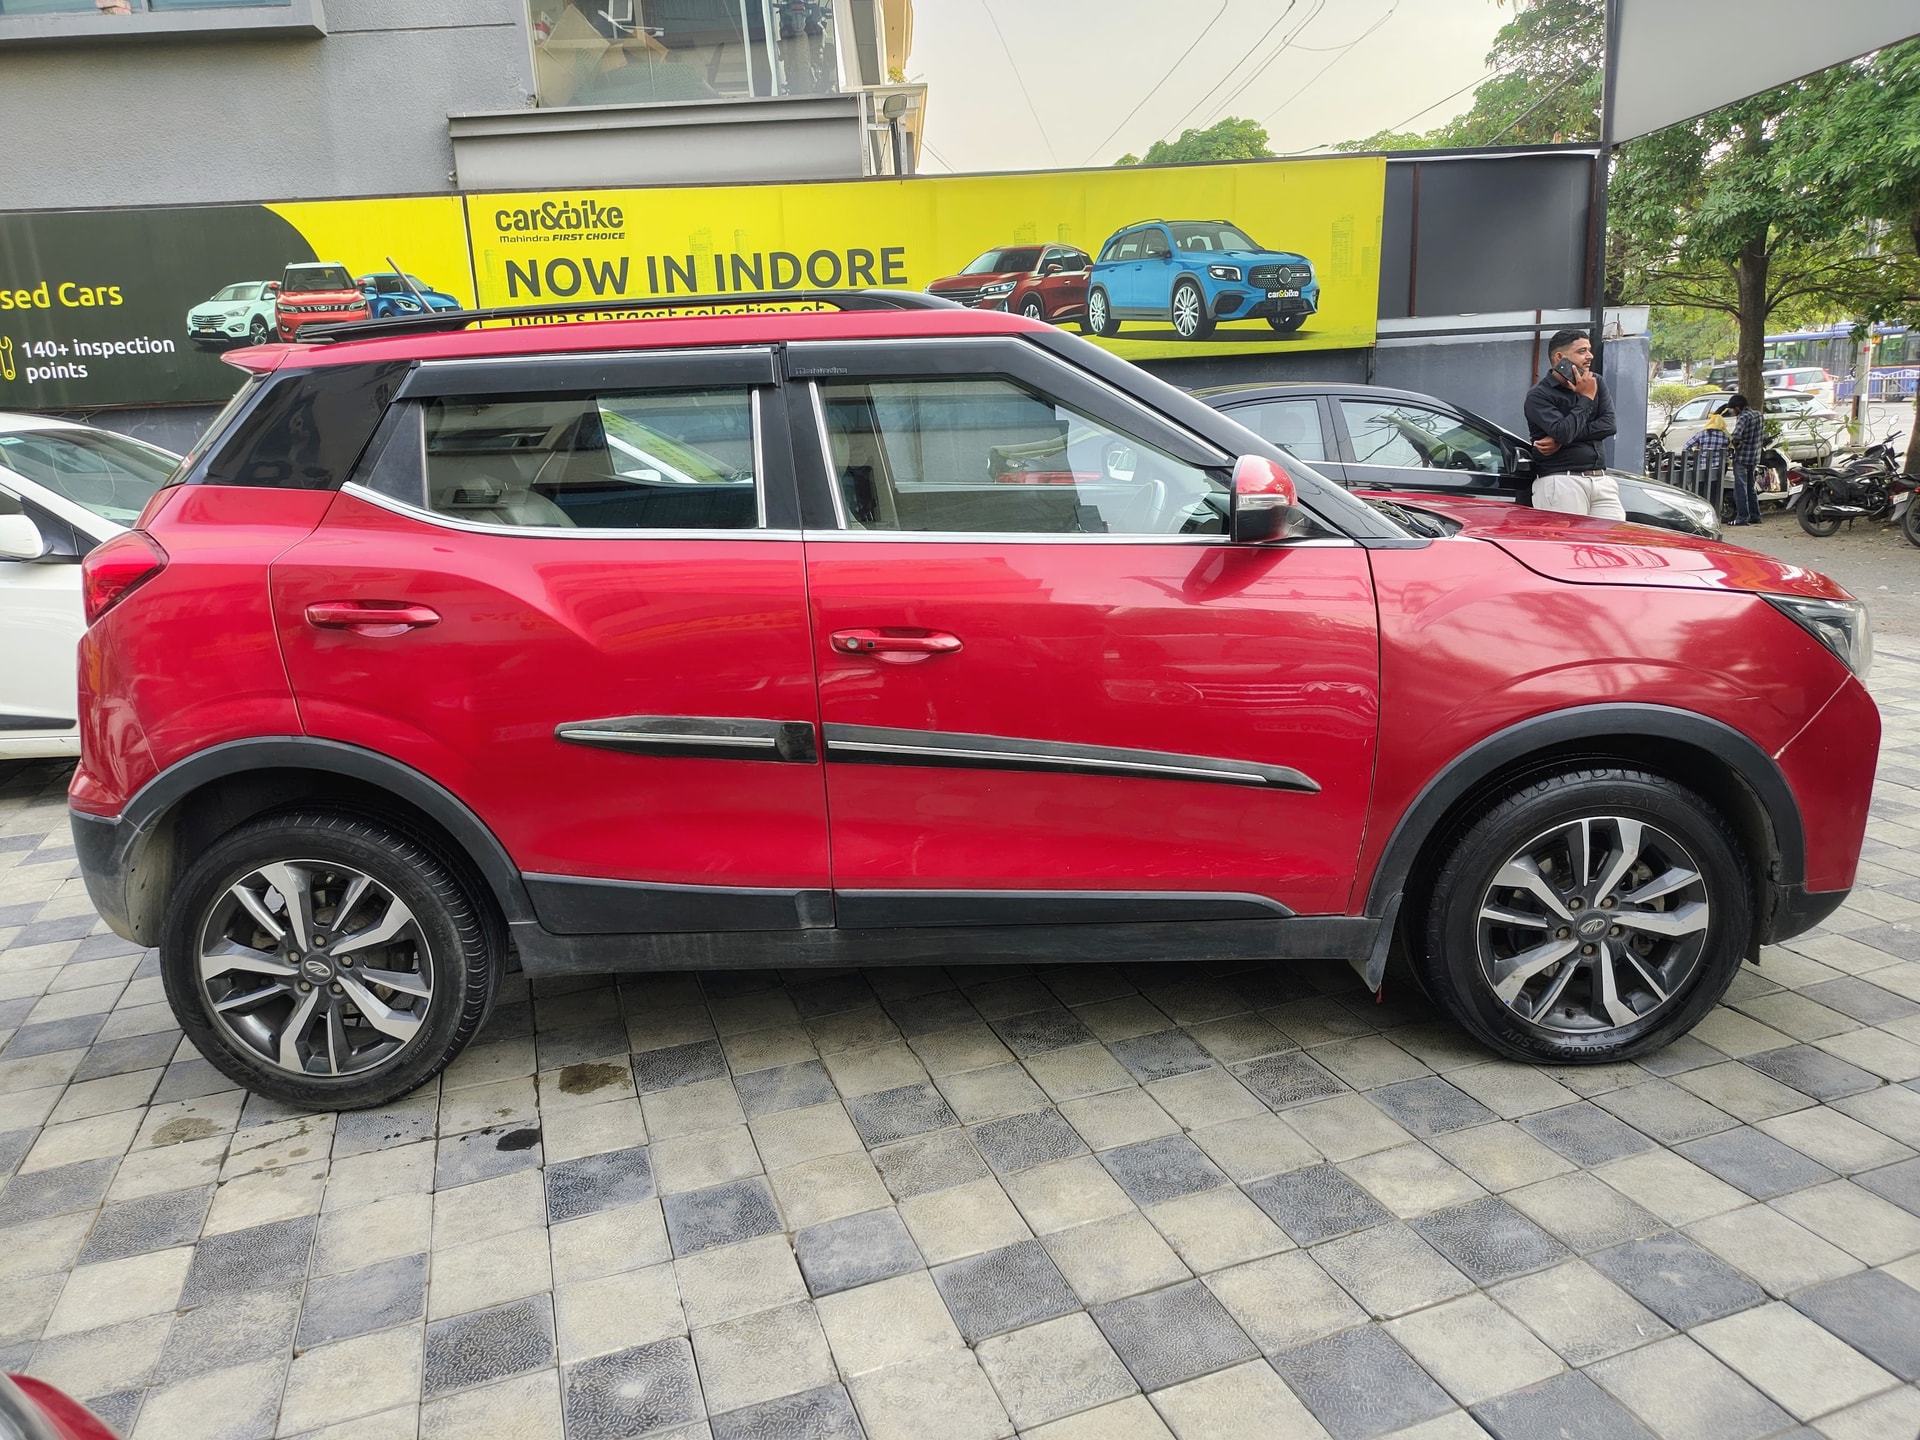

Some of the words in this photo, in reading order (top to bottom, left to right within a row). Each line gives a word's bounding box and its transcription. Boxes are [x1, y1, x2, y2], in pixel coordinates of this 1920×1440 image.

[495, 199, 624, 232] car&bike
[500, 235, 550, 243] Mahindra
[552, 233, 584, 241] FIRST
[586, 232, 626, 240] CHOICE
[504, 256, 629, 298] NOW
[646, 254, 699, 294] IN
[714, 246, 908, 291] INDORE
[58, 281, 124, 307] Cars
[1267, 289, 1299, 298] car&bike
[21, 340, 69, 358] 140+
[73, 336, 175, 359] inspection
[26, 361, 89, 384] points
